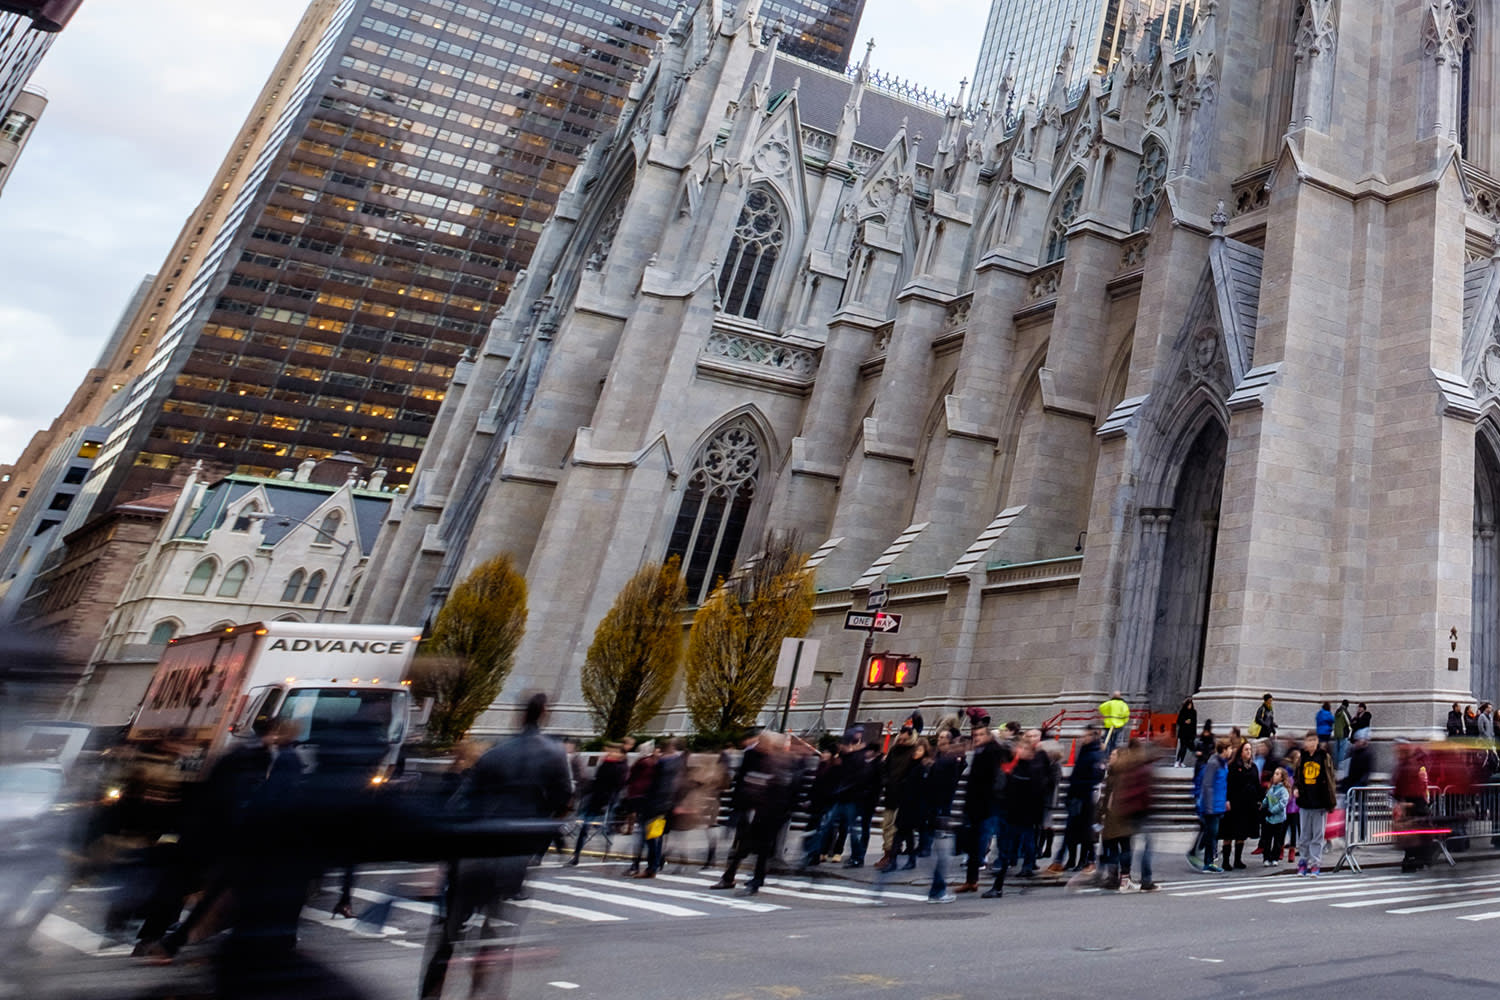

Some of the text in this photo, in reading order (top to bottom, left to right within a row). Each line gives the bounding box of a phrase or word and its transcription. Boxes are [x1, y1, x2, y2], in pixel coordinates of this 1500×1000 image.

[854, 617, 892, 627] ONE WAY
[268, 639, 405, 655] ADVANCE
